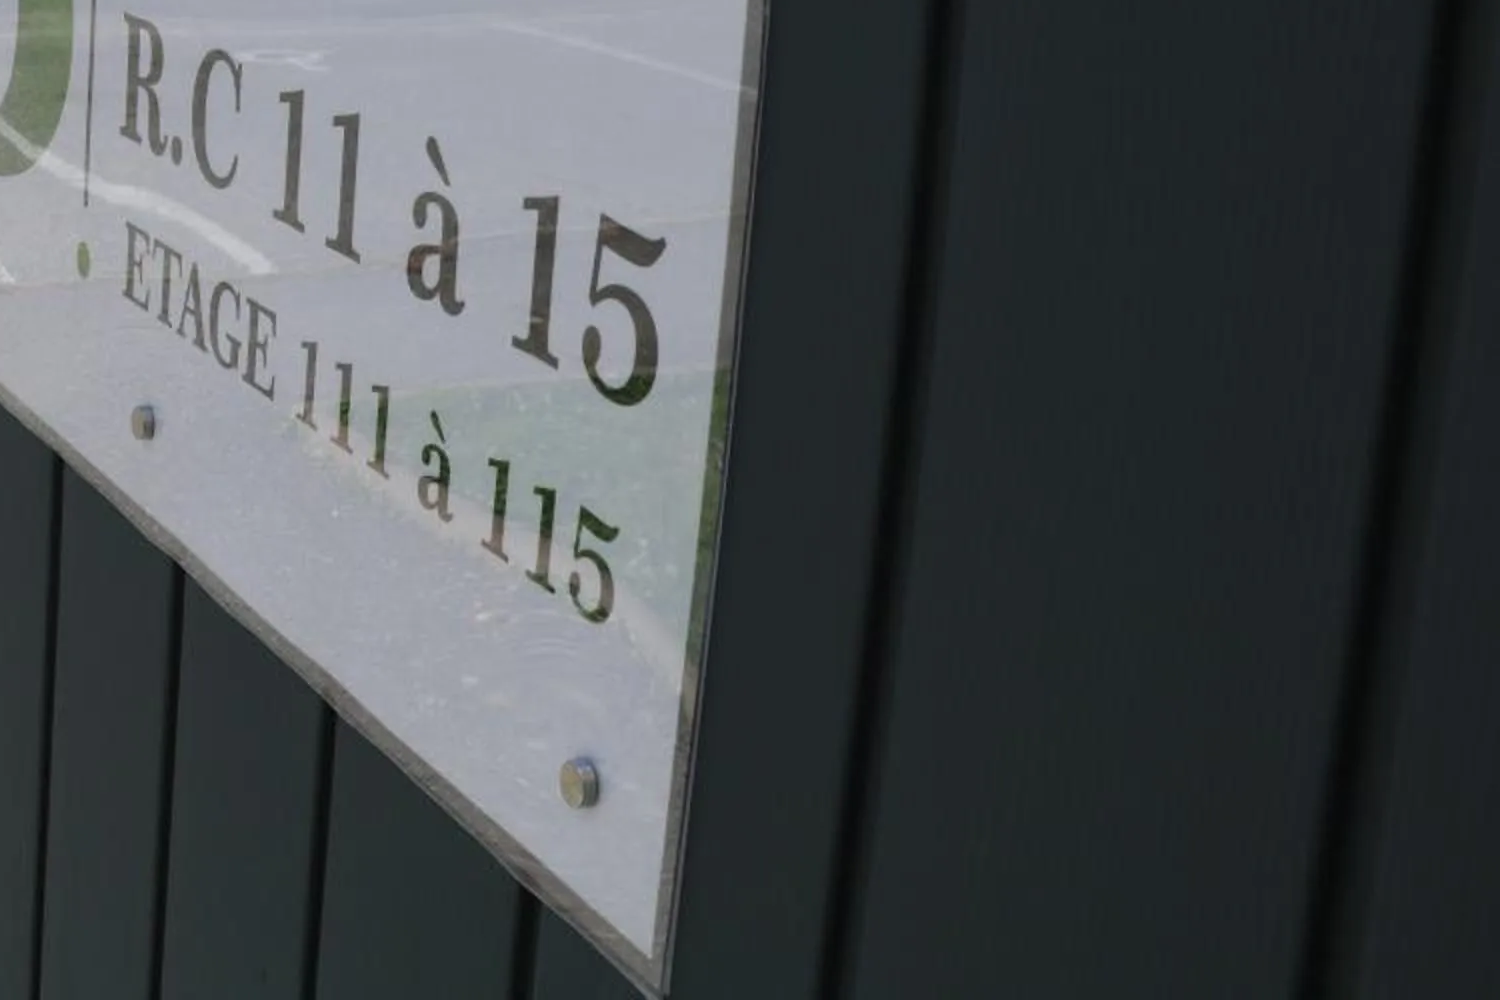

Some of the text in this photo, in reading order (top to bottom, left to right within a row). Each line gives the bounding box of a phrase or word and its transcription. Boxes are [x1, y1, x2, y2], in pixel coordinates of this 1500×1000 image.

[119, 12, 668, 408] R.C 11 à 15
[121, 221, 621, 624] ETAGE 111 à 115
